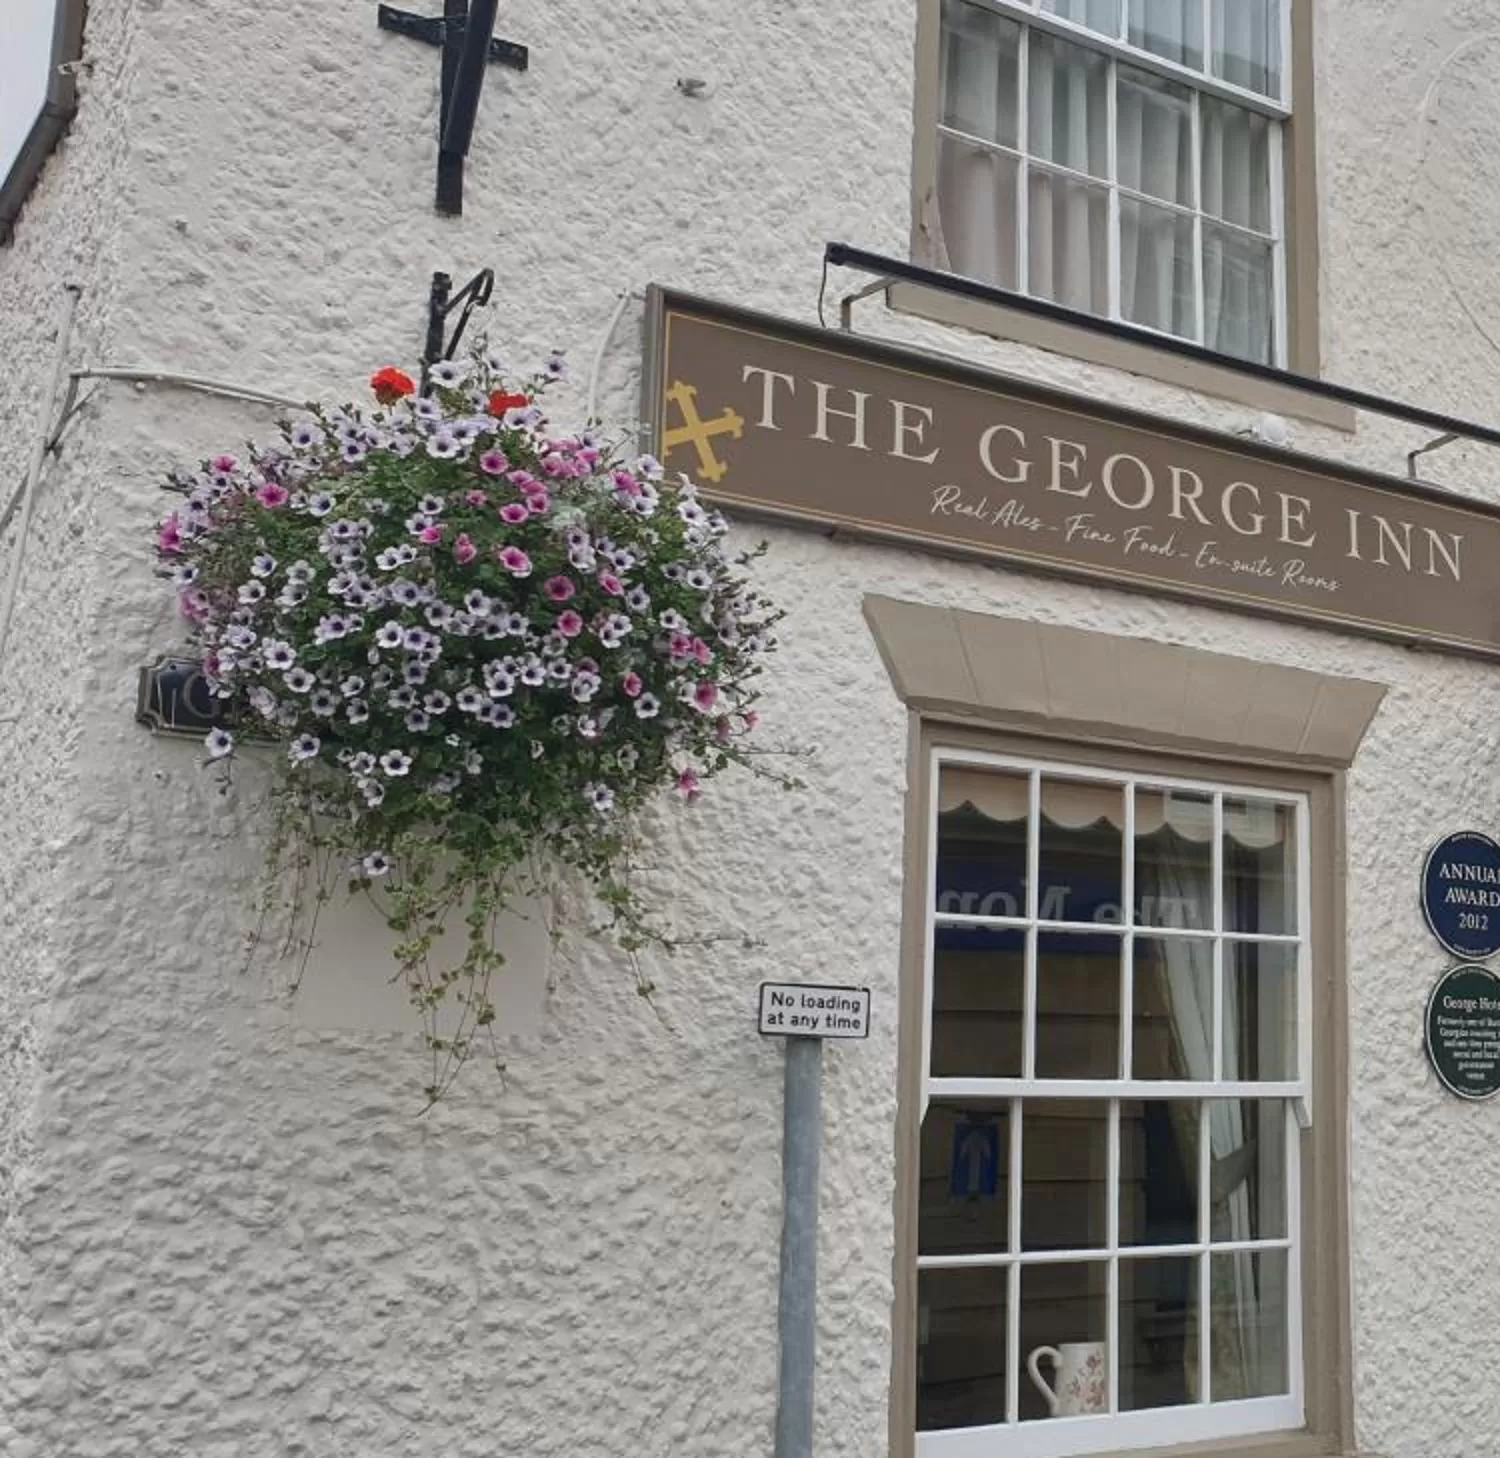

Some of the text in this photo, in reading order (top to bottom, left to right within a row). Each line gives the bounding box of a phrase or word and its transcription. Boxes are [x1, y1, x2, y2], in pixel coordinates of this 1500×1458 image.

[743, 365, 1464, 582] THE GEORGE INN
[931, 484, 989, 520] Real
[992, 499, 1044, 531] Ales
[1065, 512, 1115, 543] Fine
[1123, 525, 1176, 557] Food
[1195, 540, 1277, 578] En-suite
[1281, 558, 1345, 593] Rooms
[1445, 887, 1500, 907] AWARD
[1458, 913, 1489, 931] 2012
[771, 991, 861, 1014] No loading
[1443, 995, 1478, 1013] George
[767, 1011, 861, 1030] at any time
